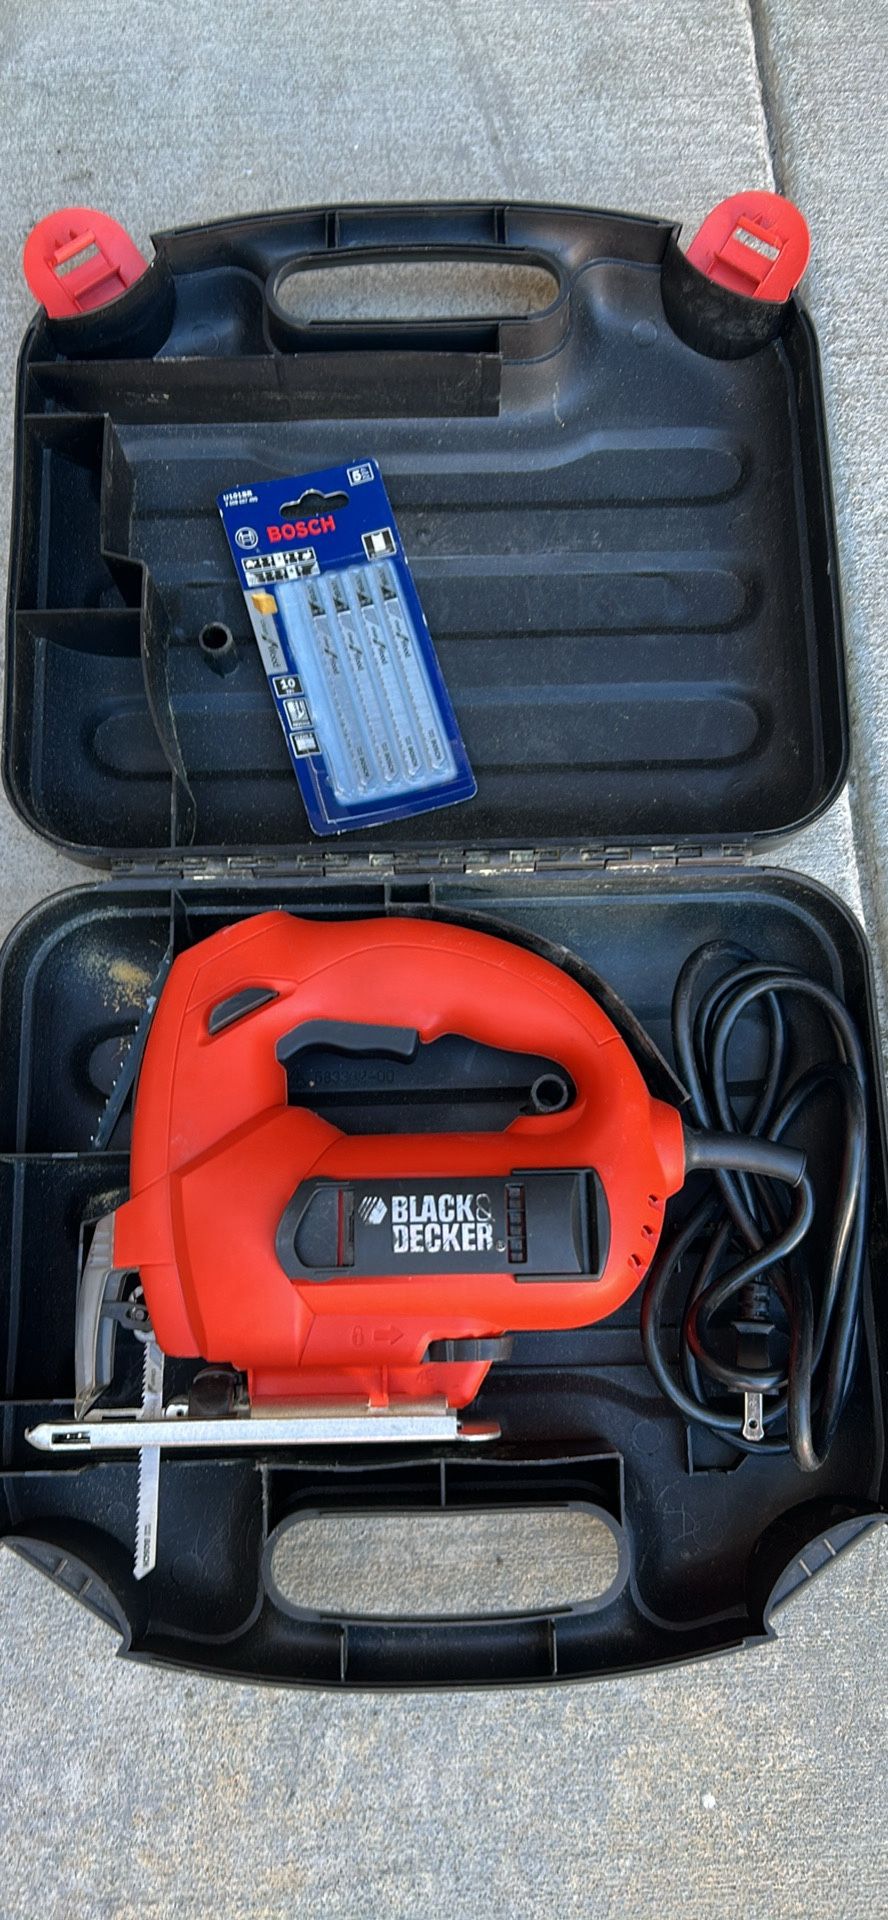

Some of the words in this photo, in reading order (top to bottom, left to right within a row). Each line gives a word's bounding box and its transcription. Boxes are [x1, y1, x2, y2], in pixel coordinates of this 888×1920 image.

[352, 470, 361, 481] 5
[266, 515, 336, 543] BOSCH
[281, 678, 296, 690] 10
[392, 1223, 493, 1253] DECKER
